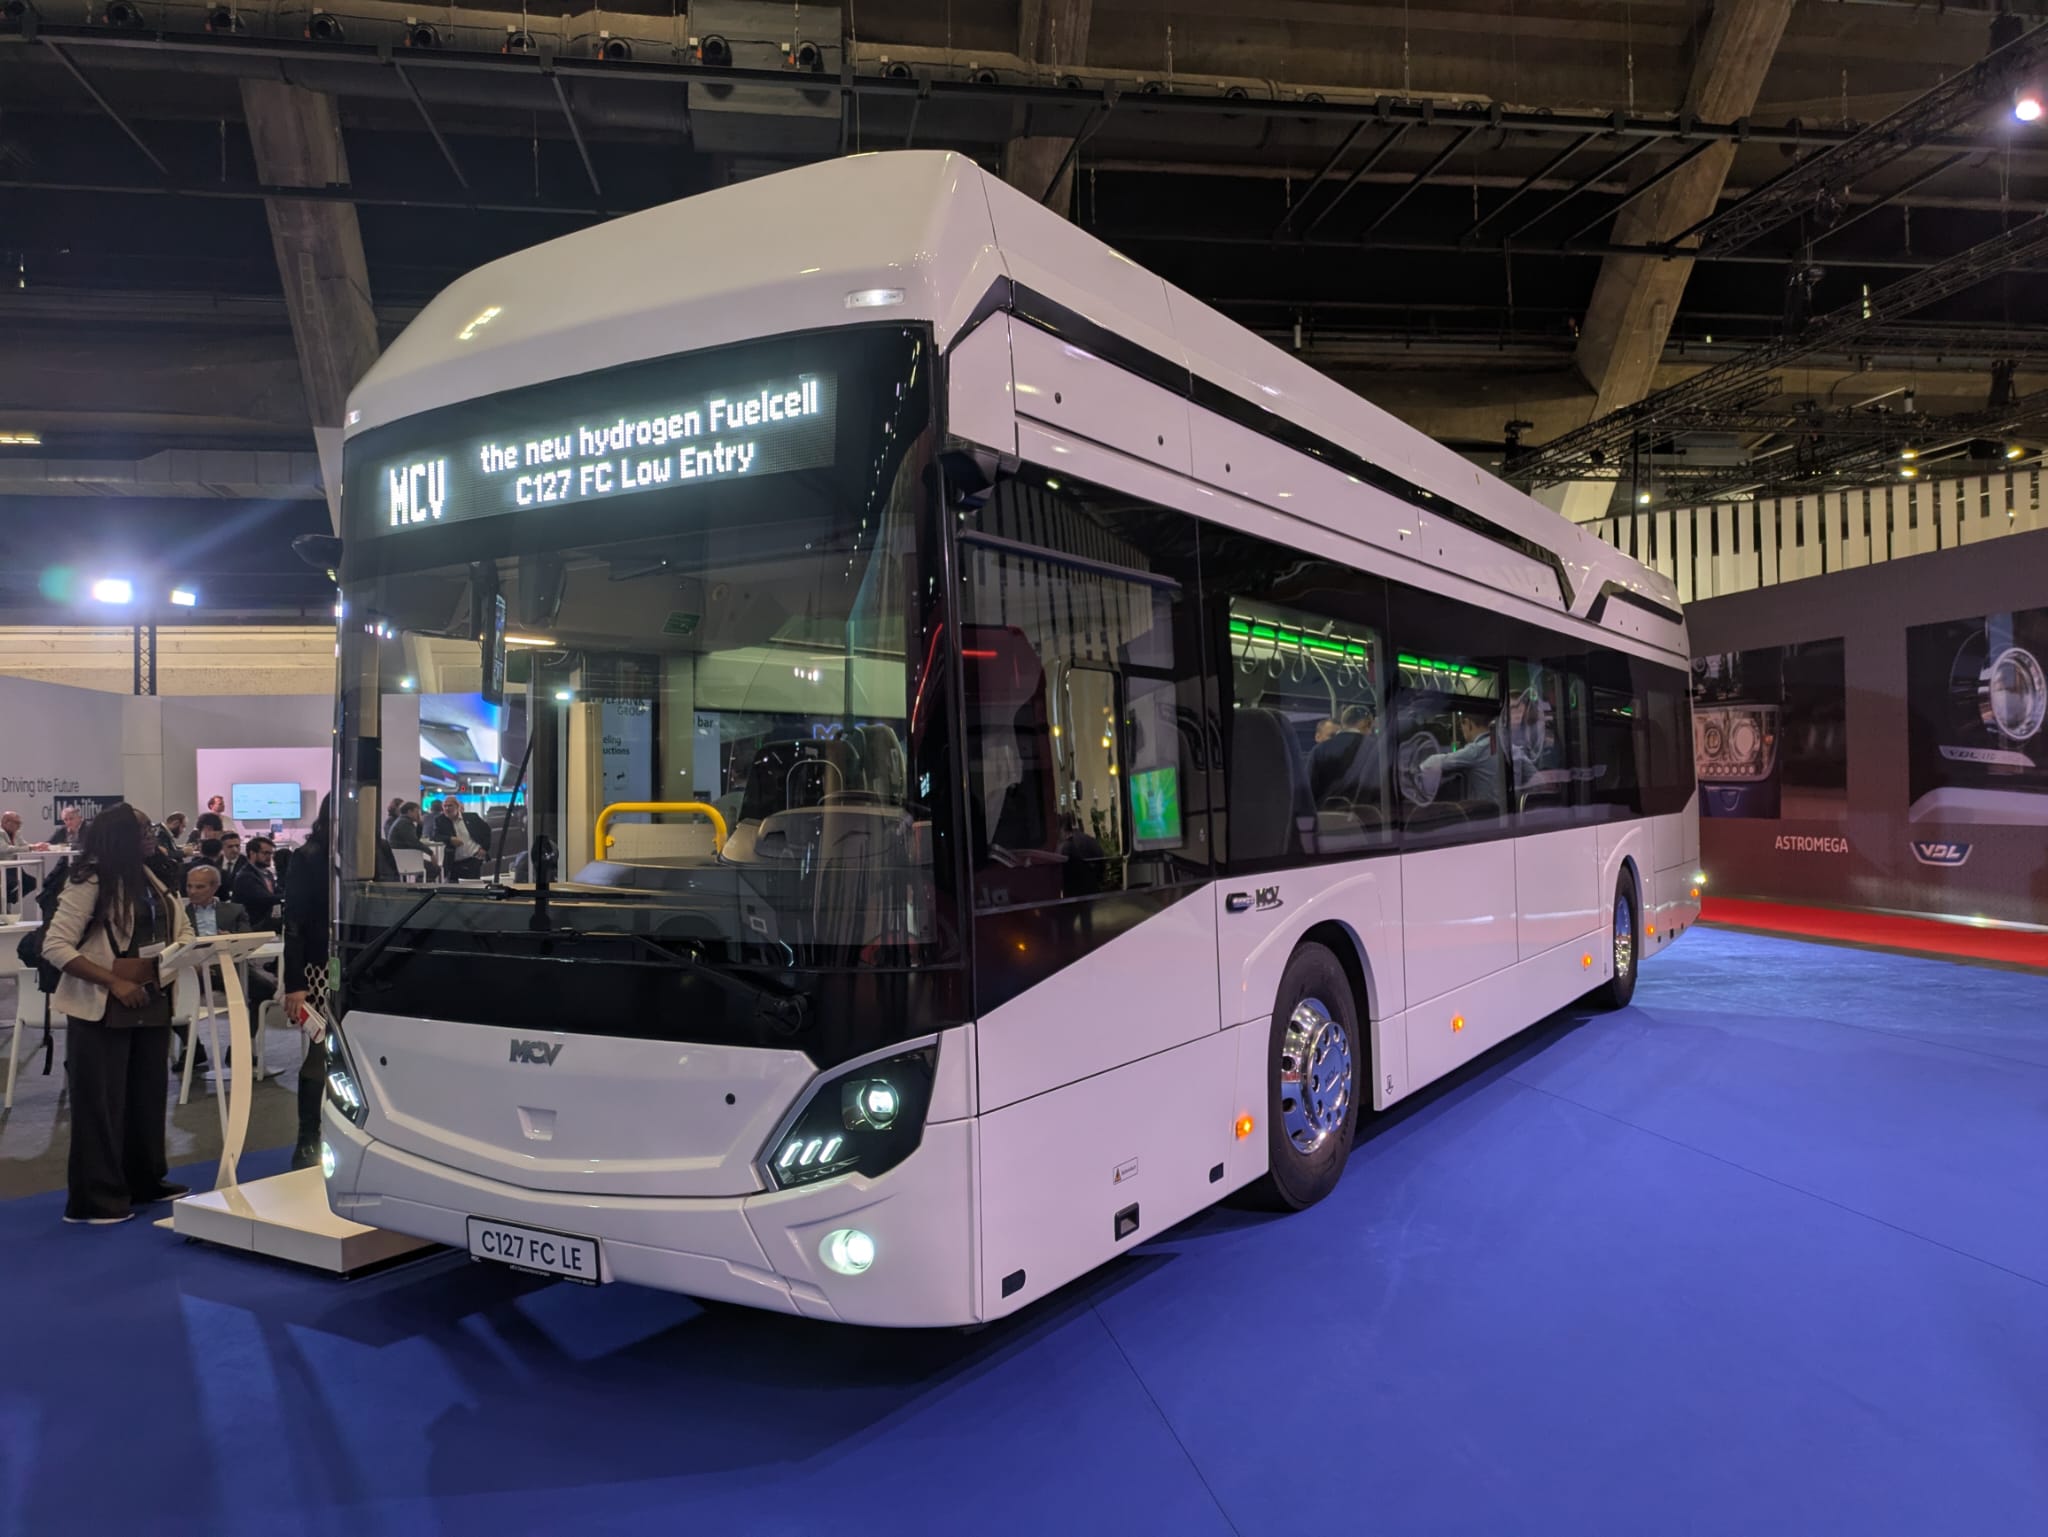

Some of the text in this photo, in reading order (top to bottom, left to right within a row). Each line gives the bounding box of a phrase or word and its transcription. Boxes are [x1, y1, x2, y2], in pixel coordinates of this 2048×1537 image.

[480, 380, 817, 473] the new hydrogen Fuelcell
[515, 442, 754, 505] C127 FC Low Entry
[389, 459, 446, 527] MCV
[697, 715, 714, 728] bar
[1, 777, 80, 798] Driving the Future
[1775, 835, 1849, 853] ASTROMEGA
[1919, 843, 1962, 859] VDL
[1255, 885, 1280, 908] MCV
[509, 1038, 563, 1067] MCV
[482, 1230, 524, 1259] C127
[530, 1239, 555, 1265] FC
[561, 1245, 582, 1271] LE
